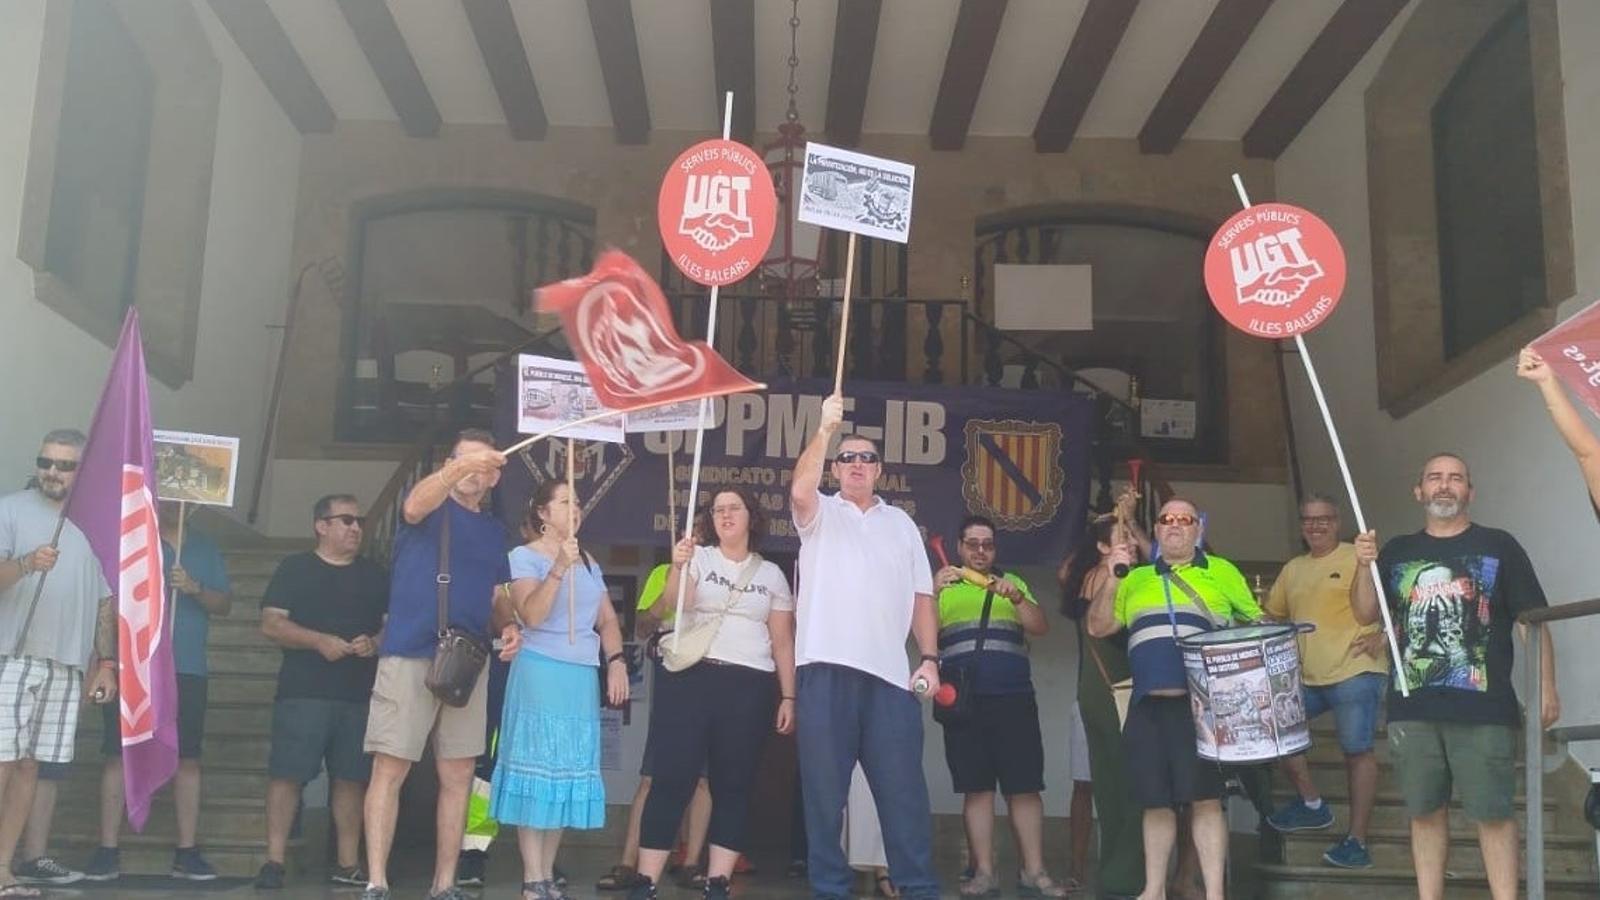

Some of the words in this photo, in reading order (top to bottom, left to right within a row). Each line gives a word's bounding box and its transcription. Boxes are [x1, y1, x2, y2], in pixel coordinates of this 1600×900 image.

[681, 149, 719, 172] SERVEIS
[721, 147, 757, 174] PÚBLICS
[683, 174, 751, 218] UGT
[1218, 215, 1255, 249] SERVEIS
[1257, 209, 1300, 225] PÚBLICS
[679, 253, 702, 279] ILLES
[704, 258, 750, 282] BALEARS
[1230, 228, 1309, 286] UGT
[1249, 318, 1282, 335] ILLES
[1285, 295, 1333, 334] BALEARS
